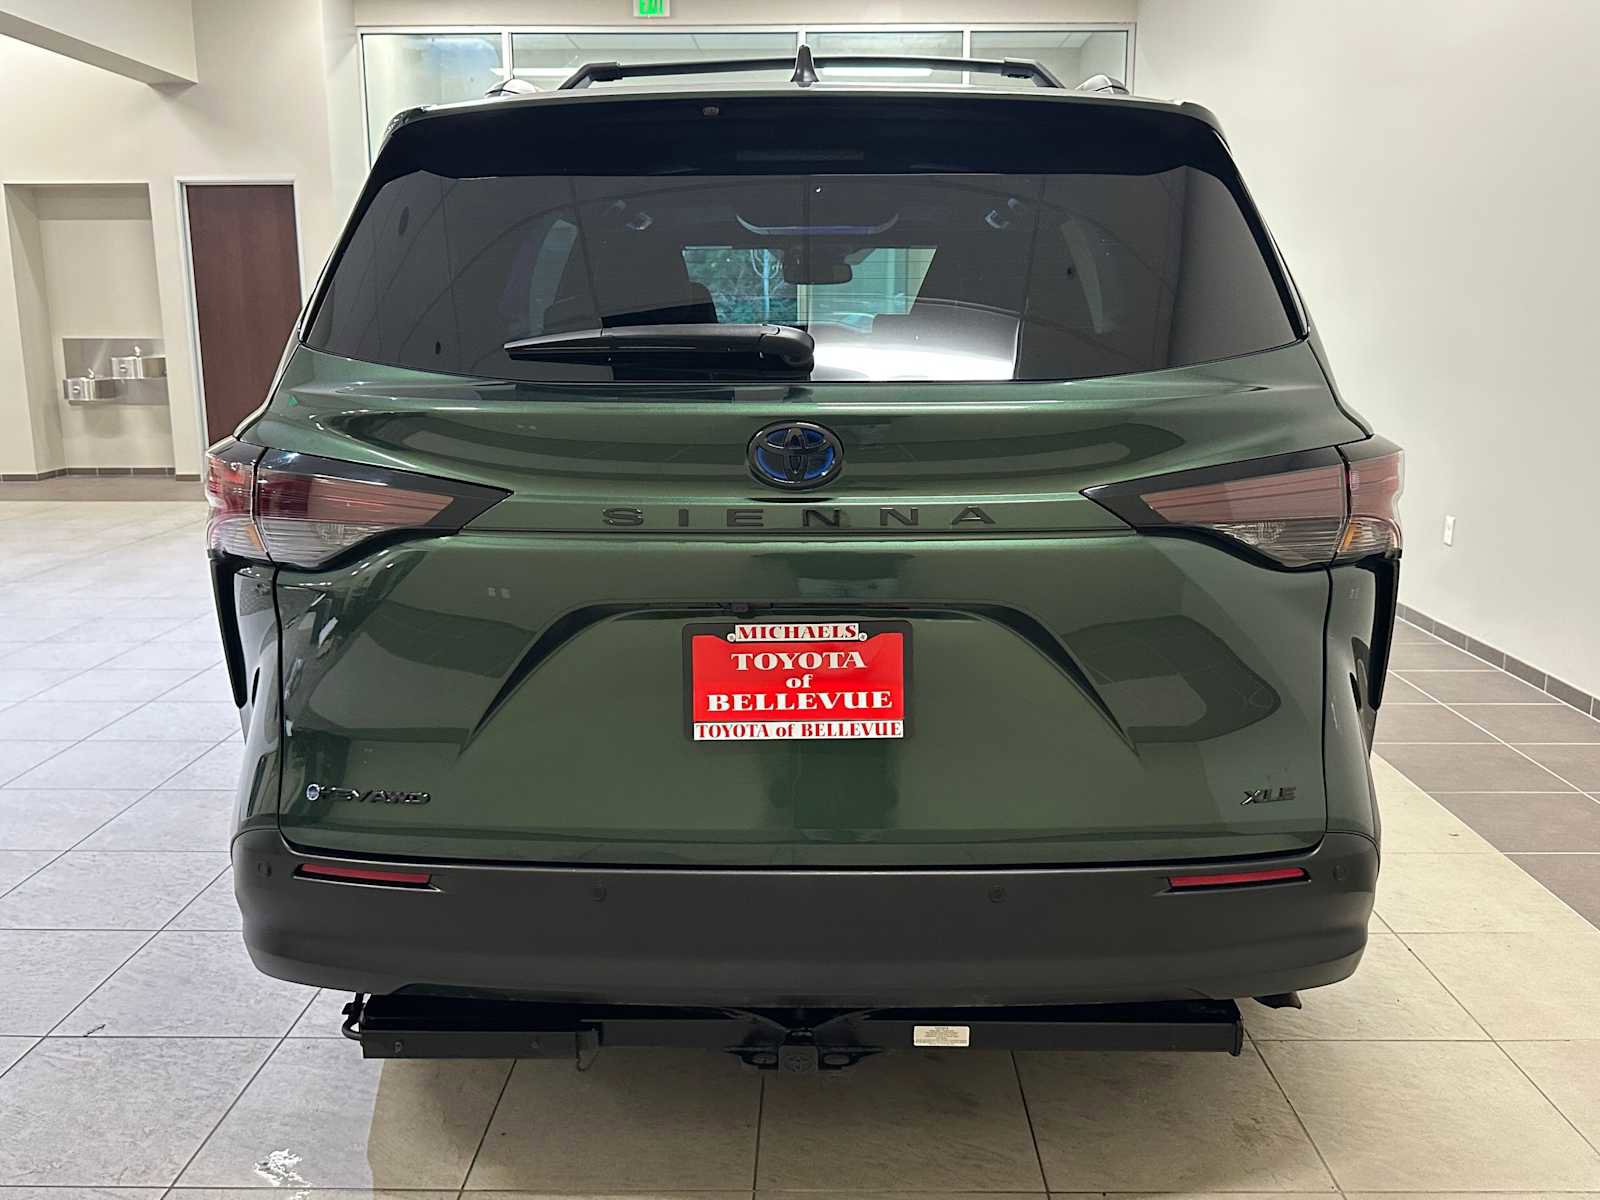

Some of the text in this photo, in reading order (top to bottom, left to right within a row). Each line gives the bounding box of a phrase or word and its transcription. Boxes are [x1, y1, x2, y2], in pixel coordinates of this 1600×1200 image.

[601, 506, 997, 527] SIENNA
[736, 624, 857, 640] MICHAELS
[731, 651, 867, 671] TOYOTA
[785, 674, 814, 689] of
[706, 691, 893, 712] BELLEVUE
[696, 722, 902, 739] TOYOTA of BELLEVUE
[1240, 787, 1297, 804] XLE
